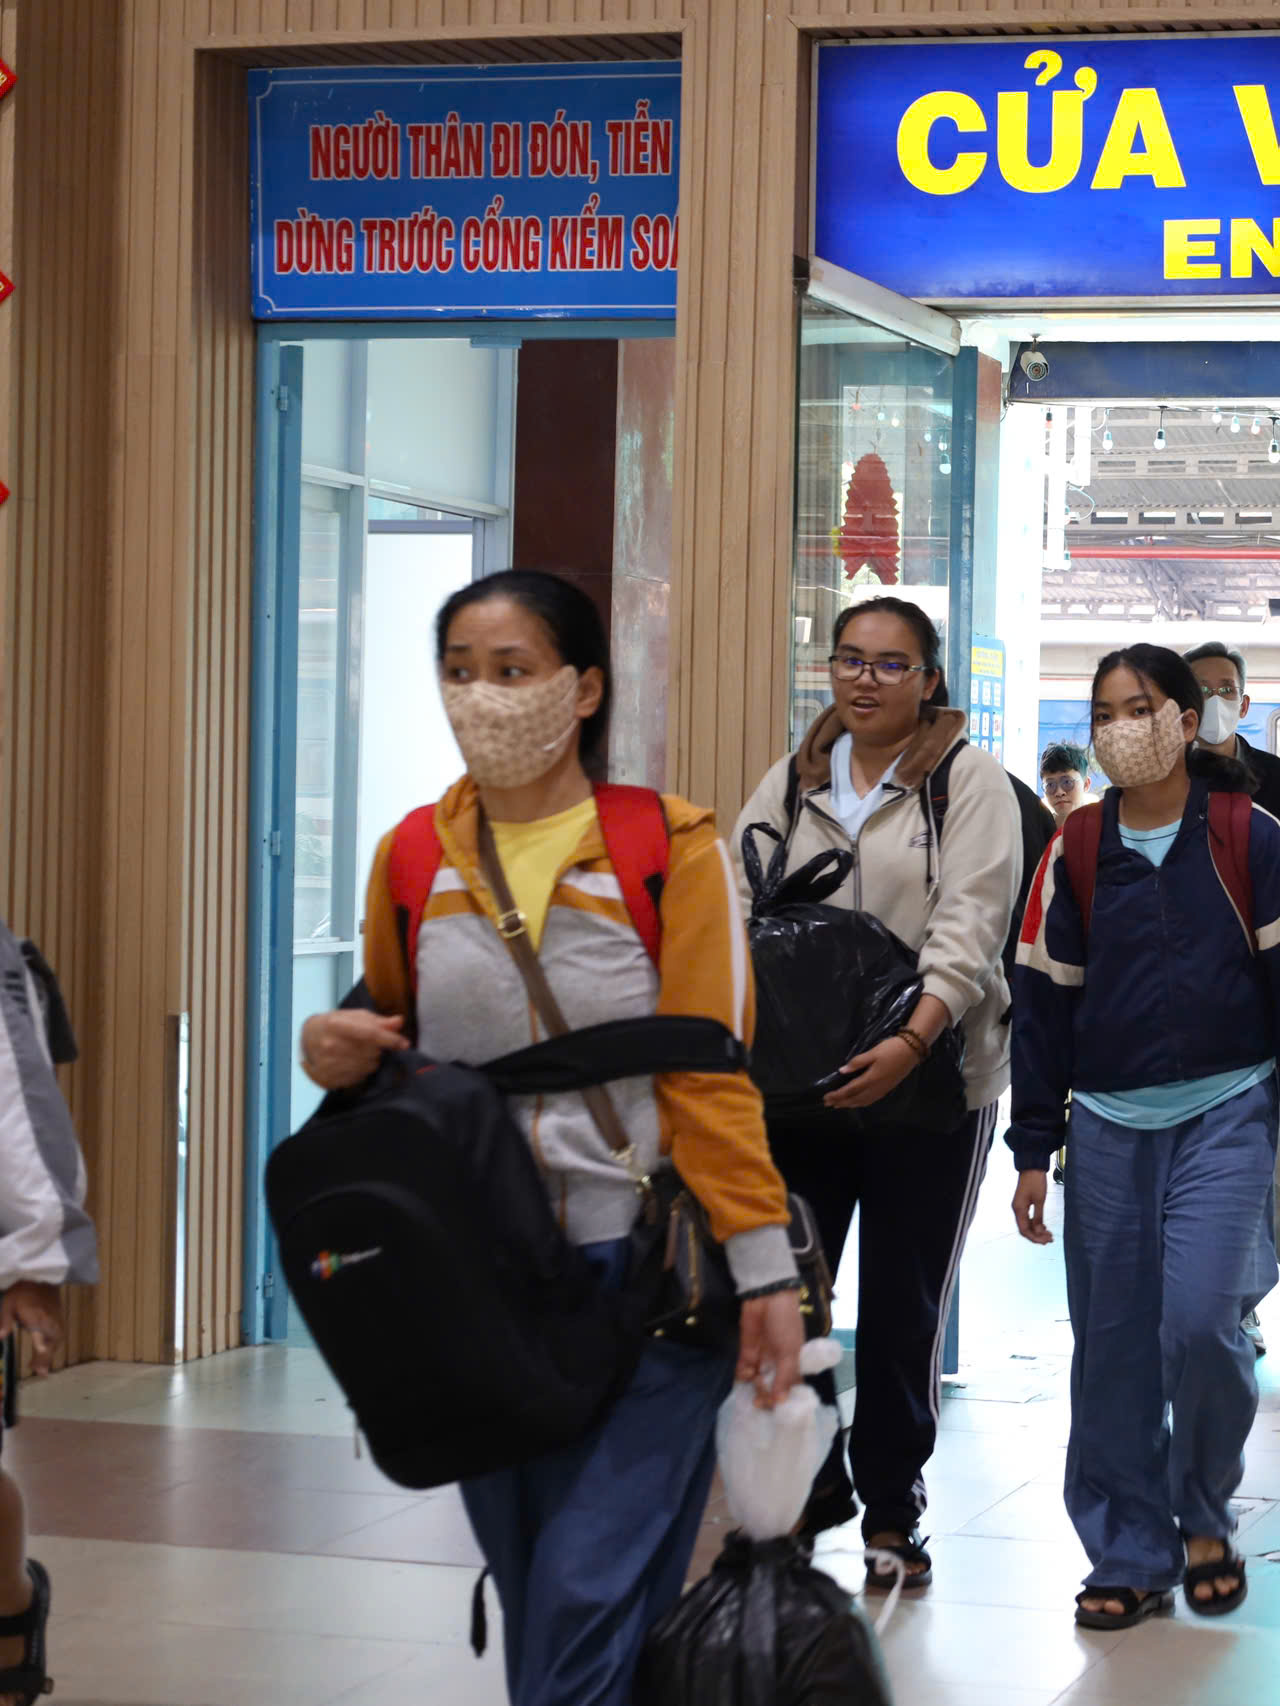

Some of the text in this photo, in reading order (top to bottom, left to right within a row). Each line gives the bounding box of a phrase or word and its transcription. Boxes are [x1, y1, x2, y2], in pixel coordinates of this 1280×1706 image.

[309, 99, 674, 184] NGƯỜI THÂN ĐI ĐÓN, TIỄN
[897, 49, 1186, 195] CỬA
[274, 207, 355, 275] DỪNG
[361, 206, 455, 274] TRƯỚC
[461, 194, 541, 273] CỔNG
[548, 193, 625, 271] KIỂM
